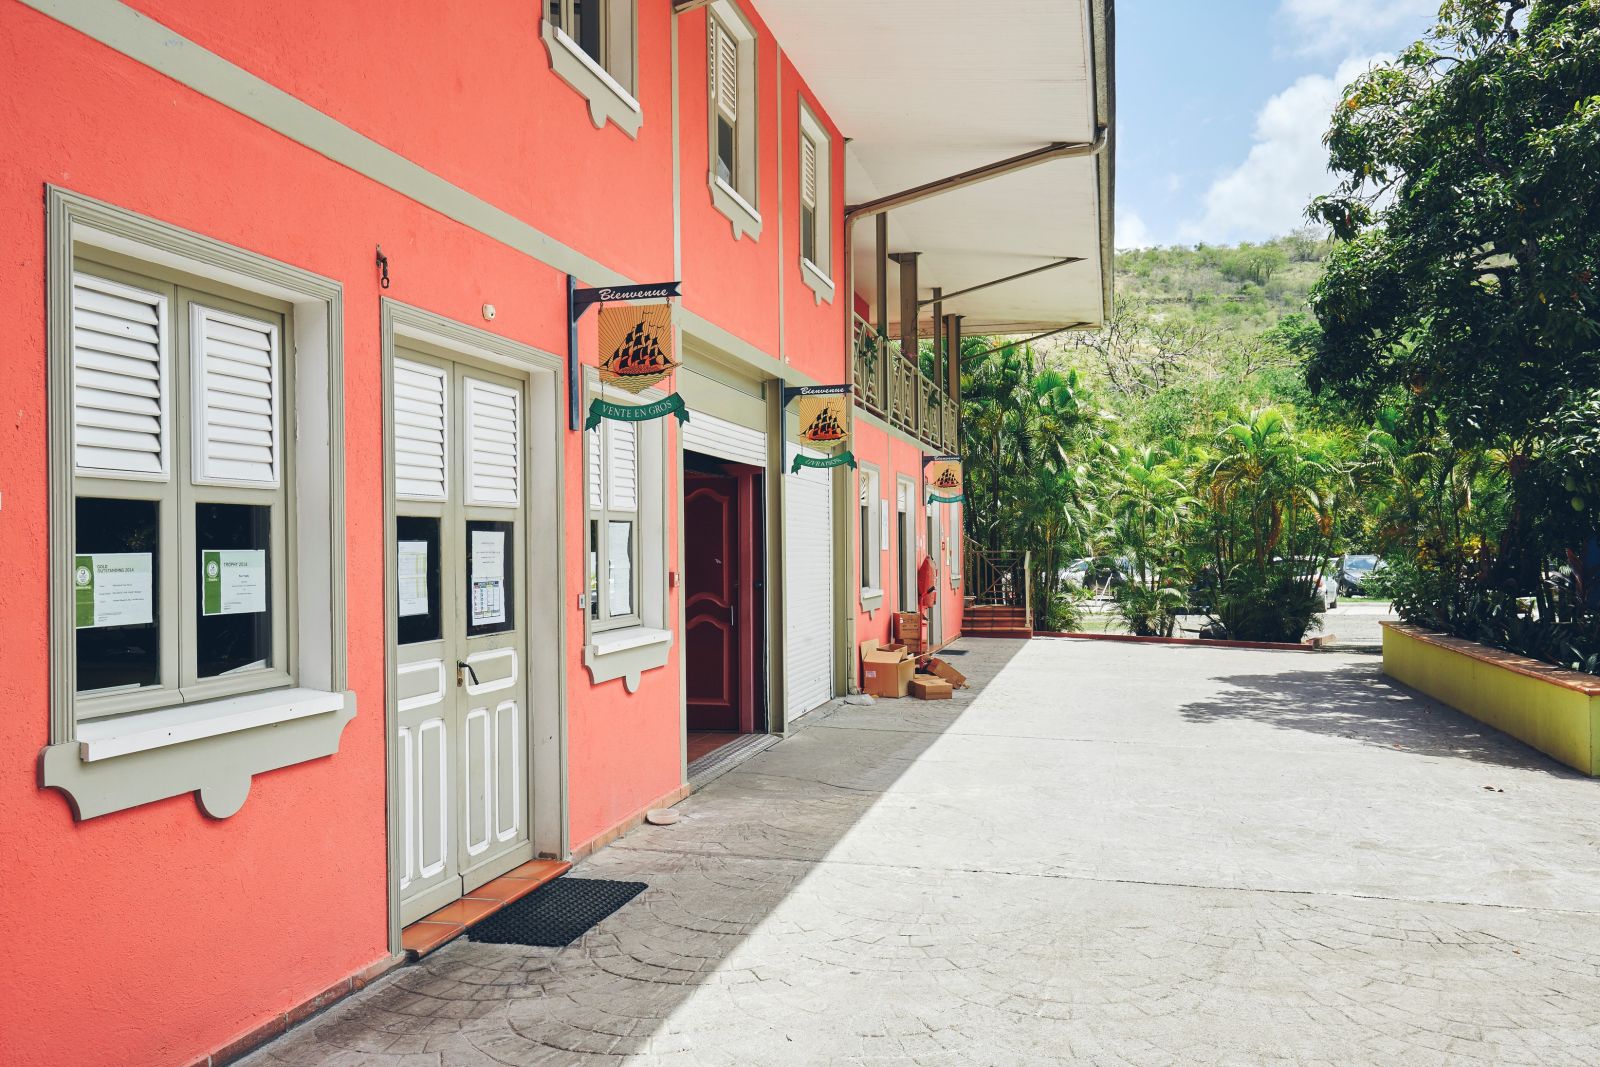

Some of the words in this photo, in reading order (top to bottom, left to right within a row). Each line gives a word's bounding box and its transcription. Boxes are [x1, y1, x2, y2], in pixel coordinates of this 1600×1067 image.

[599, 288, 668, 300] Bienvenue
[801, 387, 845, 395] Bienvenue
[603, 404, 631, 418] VENTE
[634, 409, 647, 418] EN
[648, 400, 672, 415] GROS
